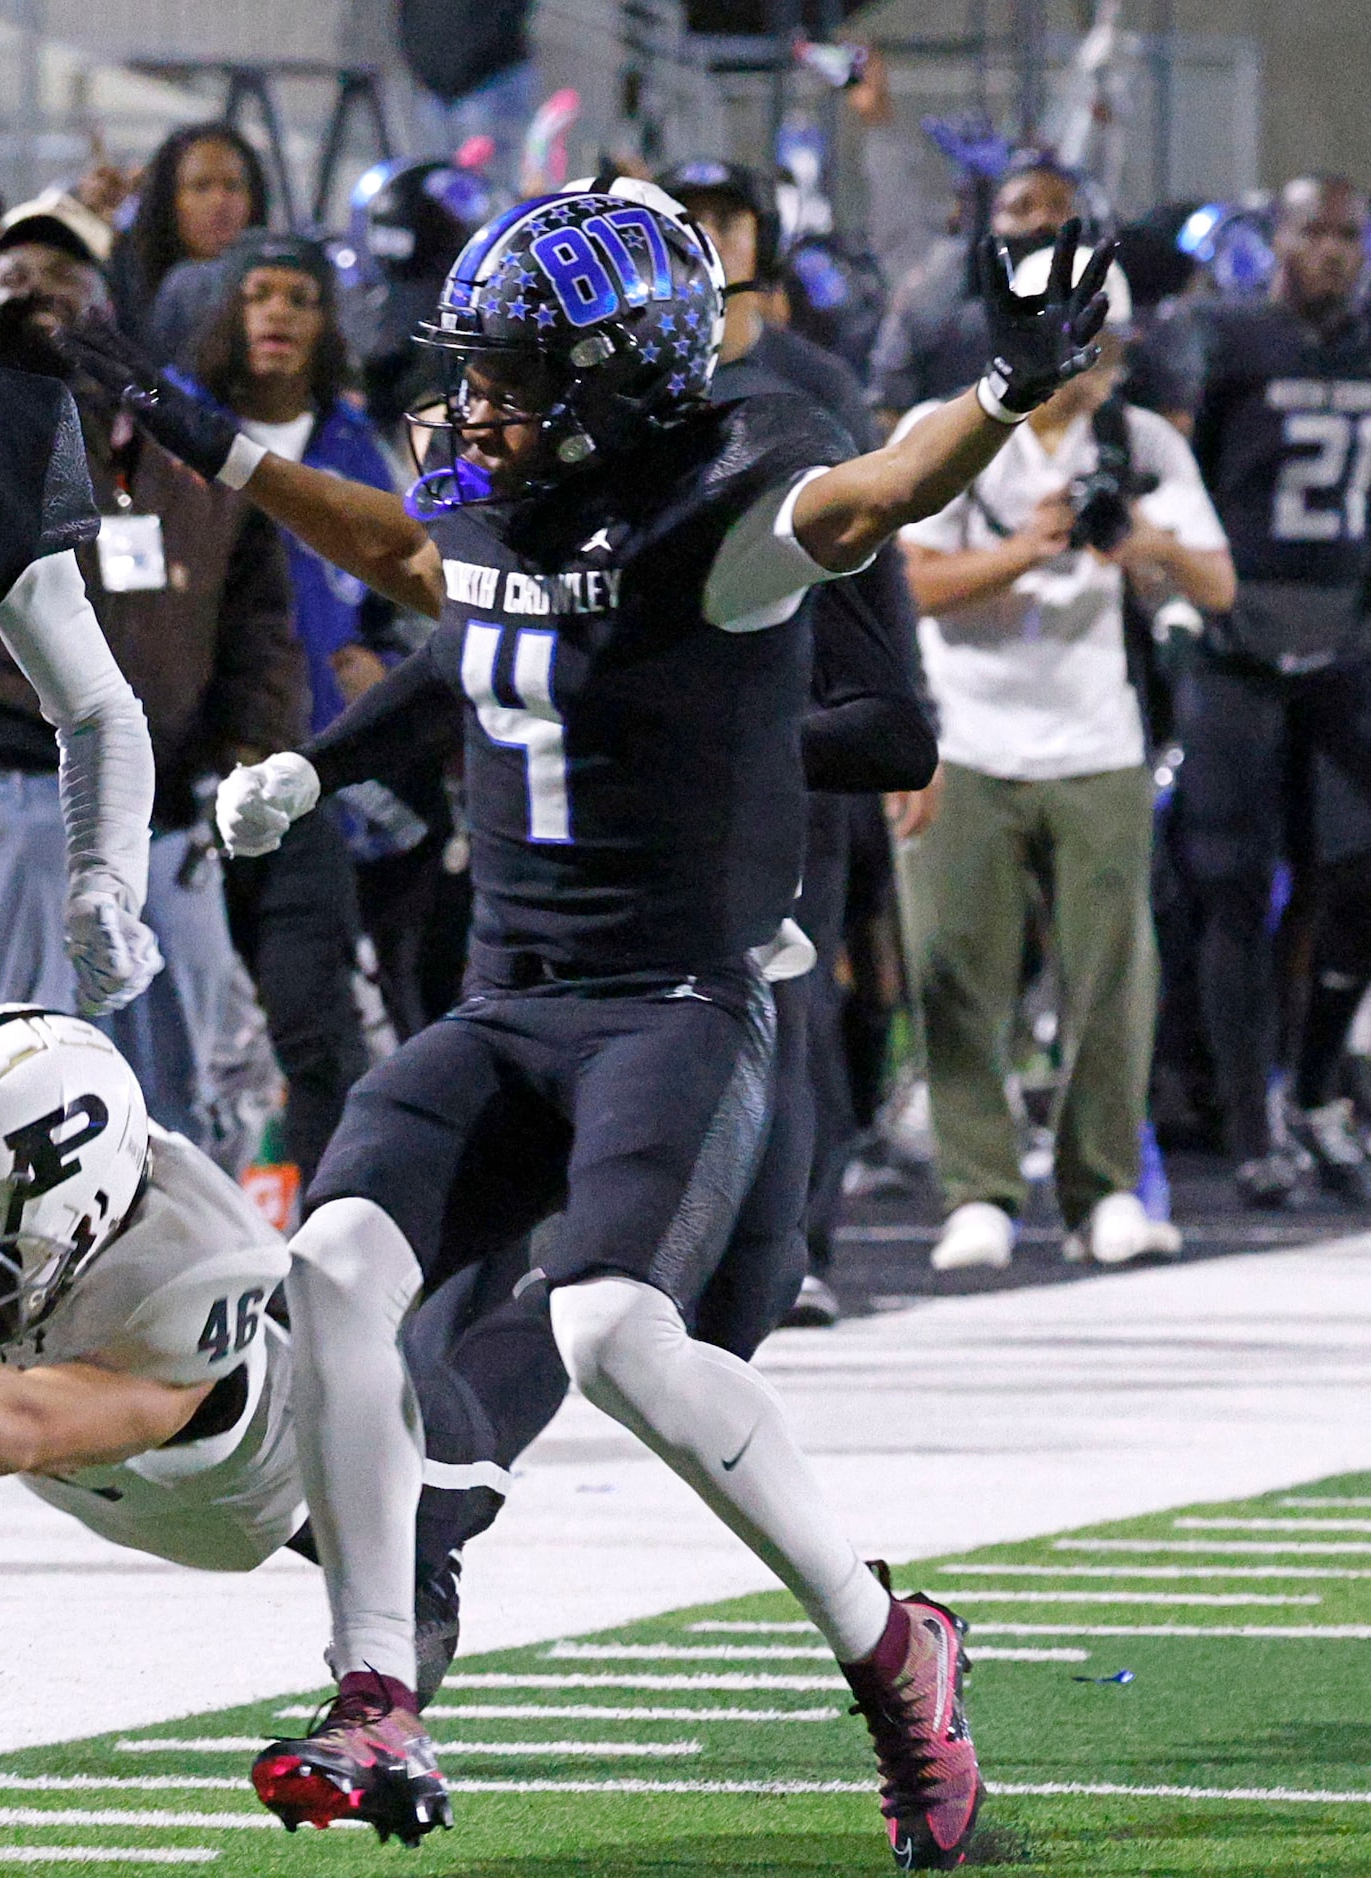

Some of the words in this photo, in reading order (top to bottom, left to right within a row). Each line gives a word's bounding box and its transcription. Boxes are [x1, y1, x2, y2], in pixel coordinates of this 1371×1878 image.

[530, 208, 673, 327] 817
[503, 568, 621, 615] CROWLEY
[460, 619, 575, 845] 4
[198, 1285, 265, 1365] 46
